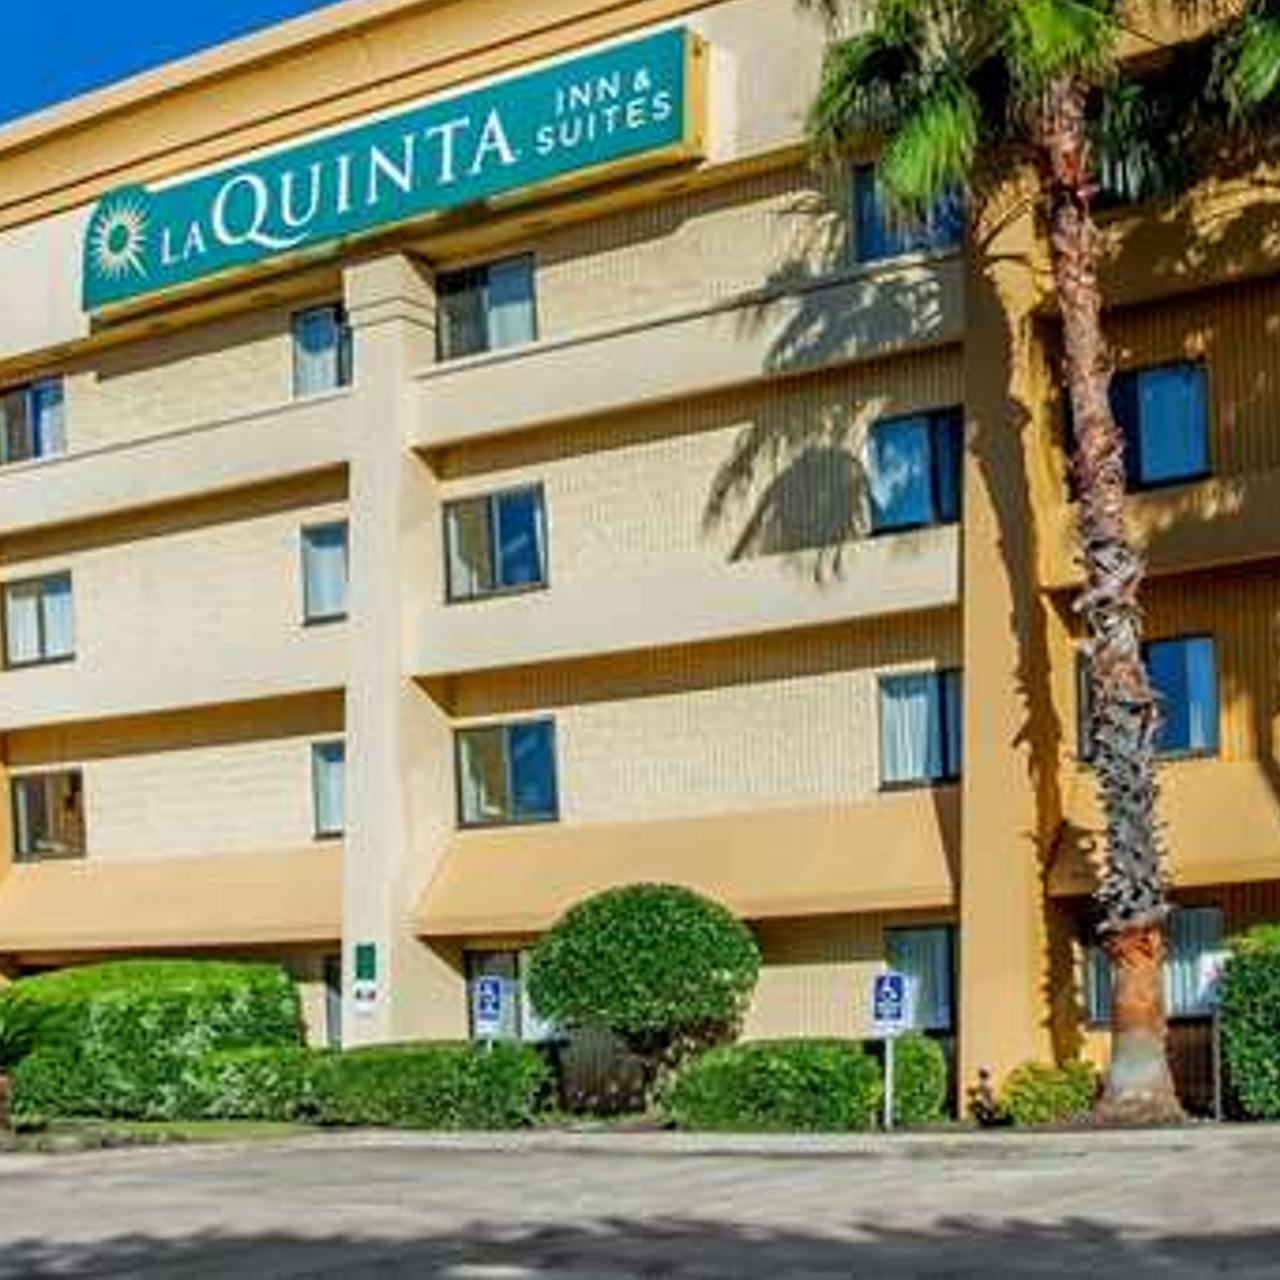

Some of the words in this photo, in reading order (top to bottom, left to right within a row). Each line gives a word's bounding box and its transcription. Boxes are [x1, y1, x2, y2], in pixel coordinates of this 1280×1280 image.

[556, 70, 620, 114] INN
[633, 67, 652, 91] &
[536, 93, 672, 155] SUITES
[160, 222, 207, 265] LA
[211, 109, 518, 249] QUINTA
